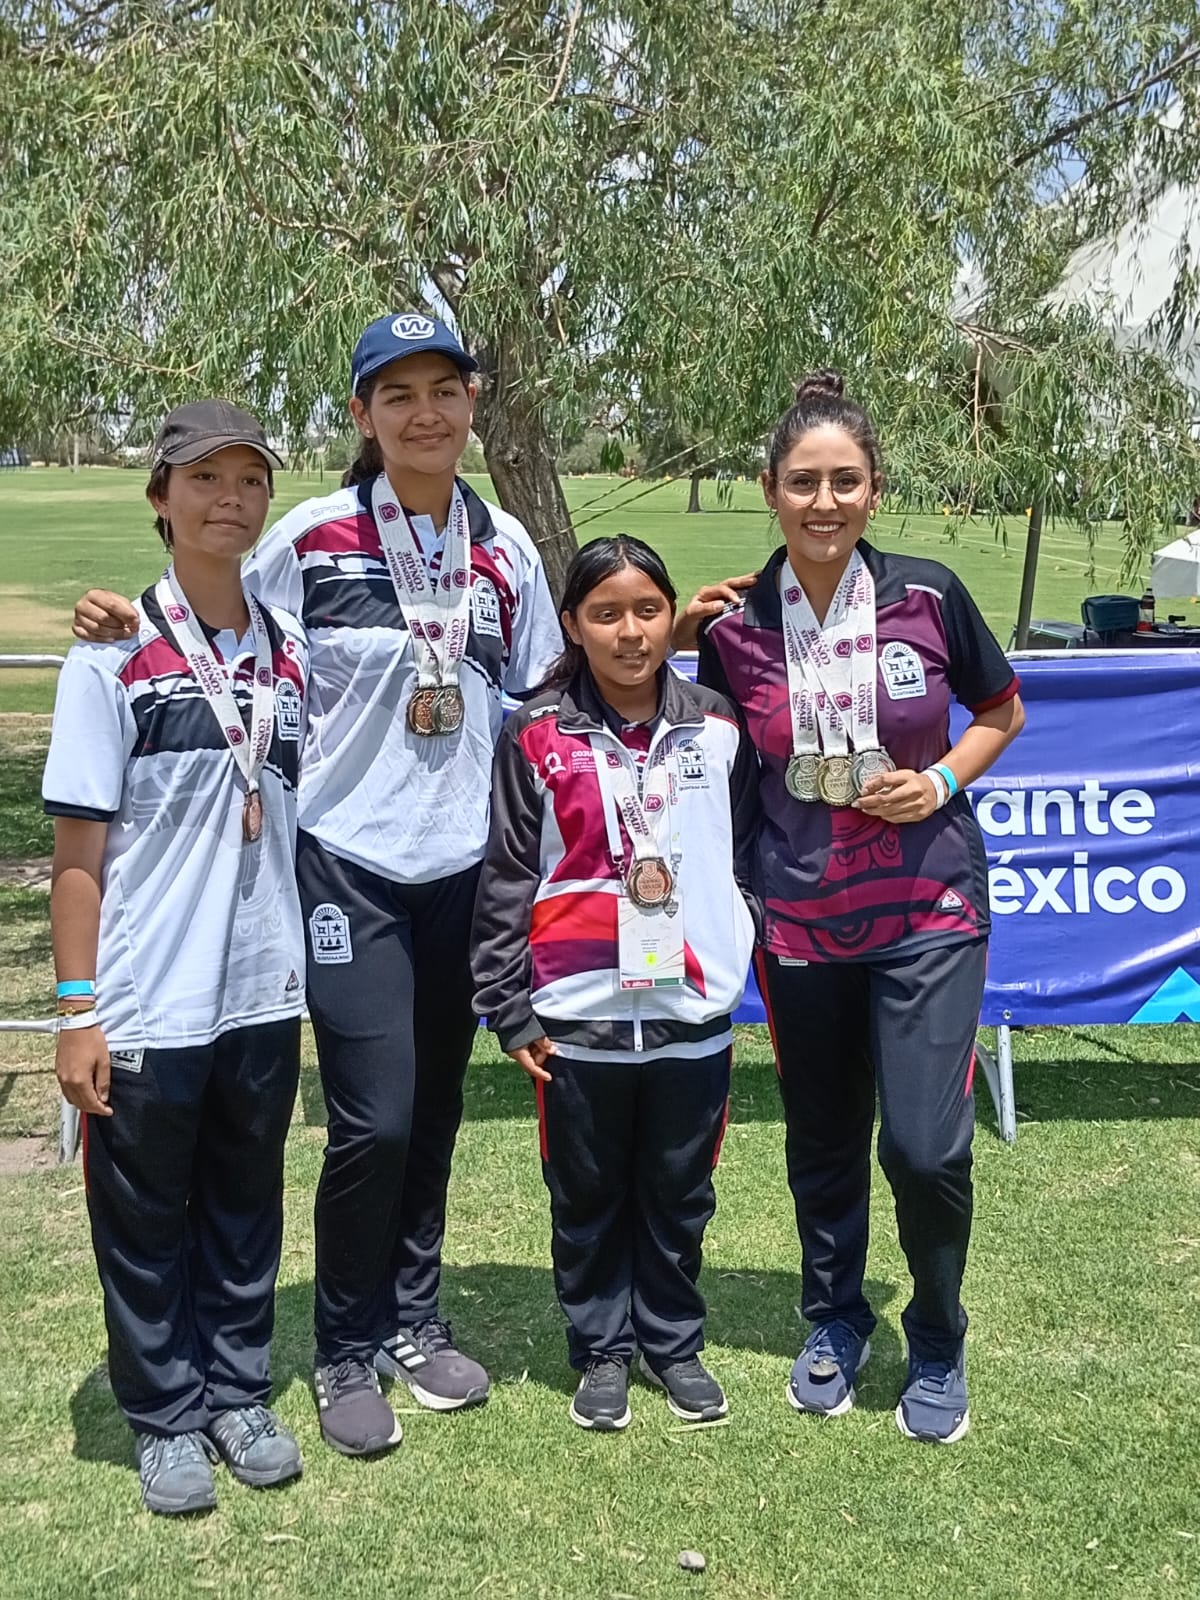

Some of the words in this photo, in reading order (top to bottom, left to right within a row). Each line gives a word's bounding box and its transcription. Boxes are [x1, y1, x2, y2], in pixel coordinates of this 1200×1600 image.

[403, 551, 425, 591] CONADE
[448, 618, 460, 661] CONADE
[808, 627, 831, 665] CONADE
[197, 651, 223, 695] CONADE
[799, 689, 809, 731] CONADE
[858, 683, 867, 726] CONADE
[256, 718, 266, 760] CONADE
[623, 796, 643, 836] CONADE
[965, 779, 1156, 836] ante
[988, 850, 1187, 915] éxico
